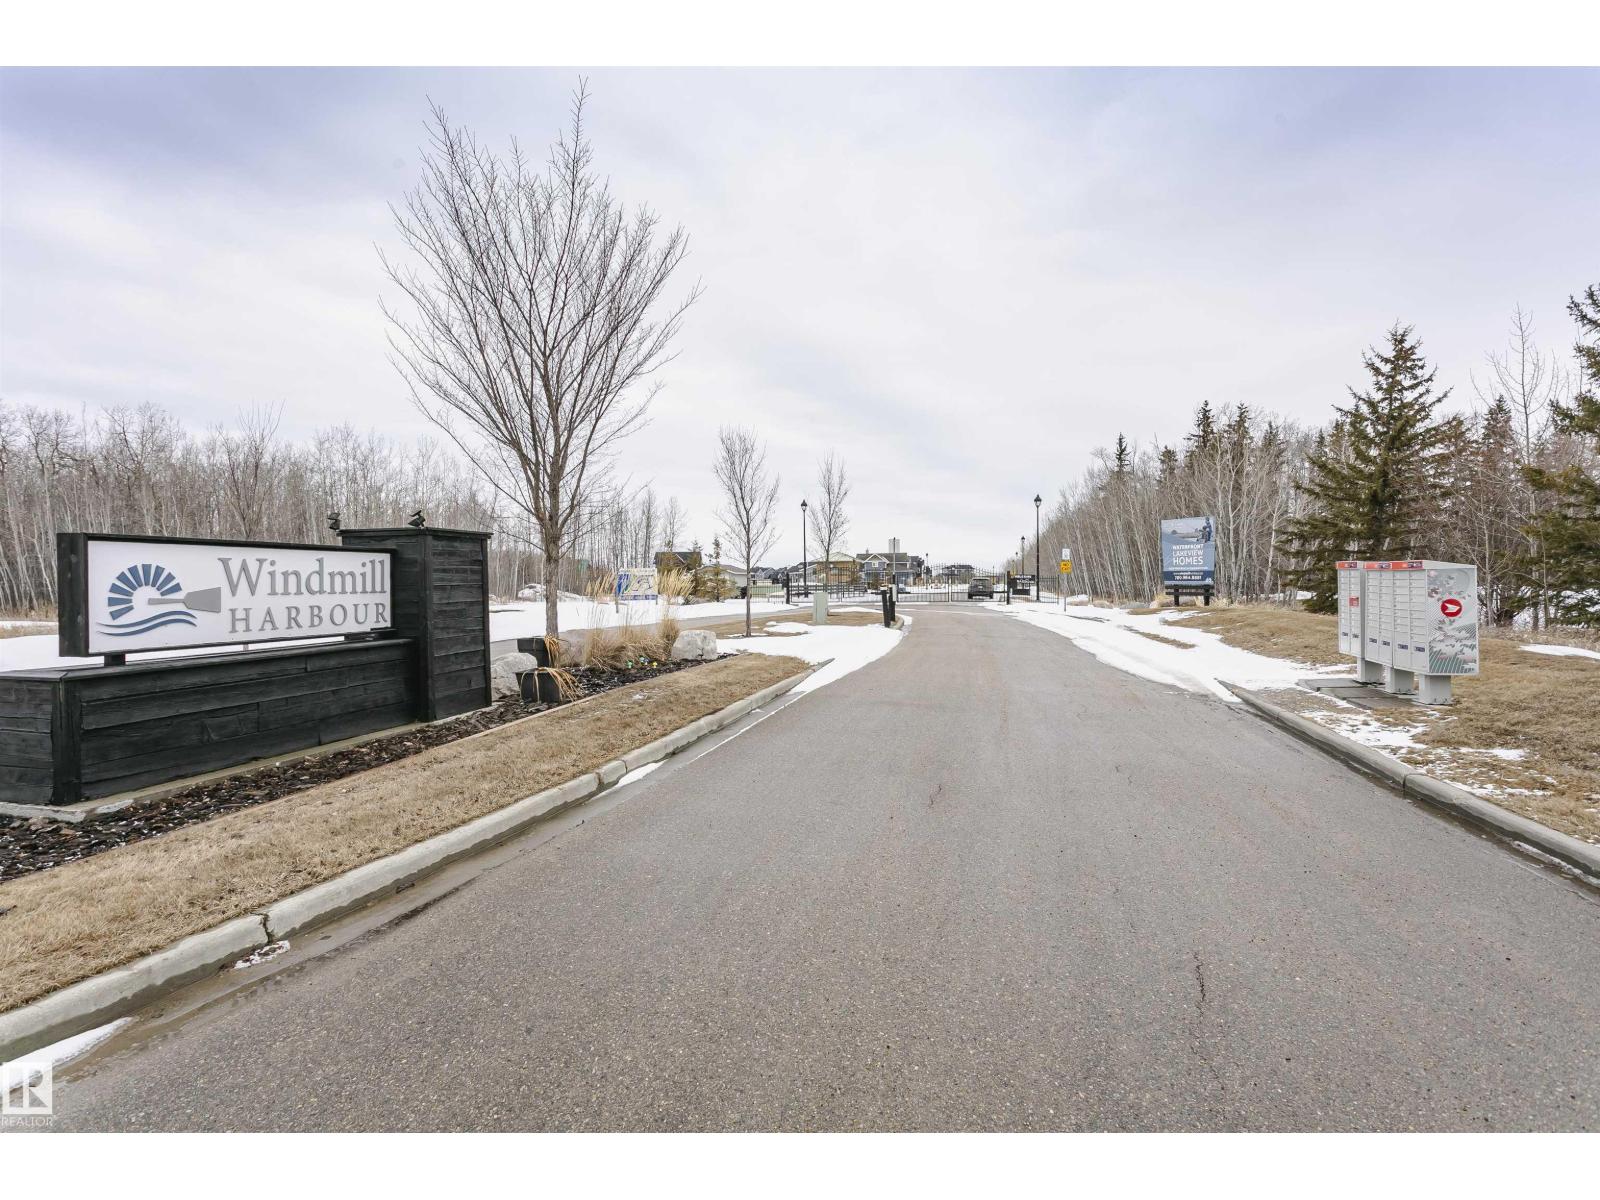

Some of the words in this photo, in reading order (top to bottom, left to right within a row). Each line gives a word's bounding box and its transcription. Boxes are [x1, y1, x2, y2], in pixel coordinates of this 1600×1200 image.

[1172, 549, 1204, 557] LAKEVIEW
[1172, 556, 1204, 566] HOMES
[217, 556, 388, 598] Windmill
[228, 602, 388, 634] HARBOUR
